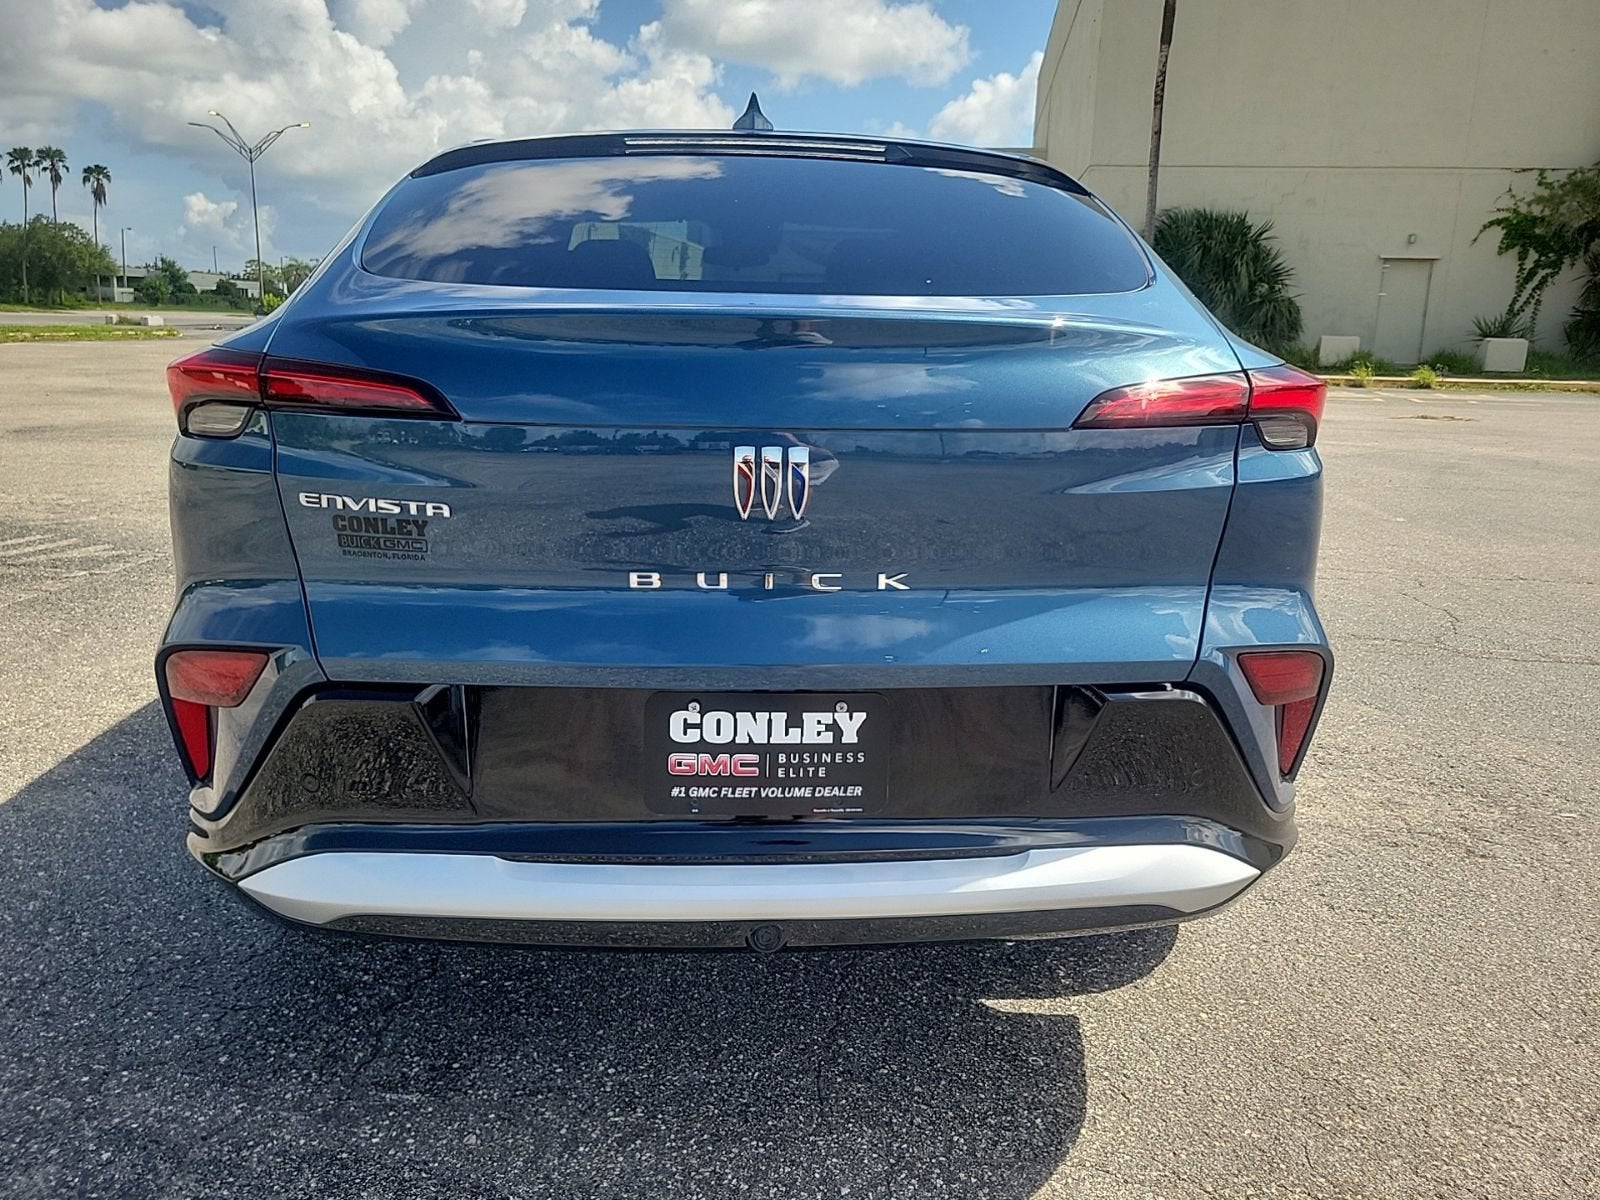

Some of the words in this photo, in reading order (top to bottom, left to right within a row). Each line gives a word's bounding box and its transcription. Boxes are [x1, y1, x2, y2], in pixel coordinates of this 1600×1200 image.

[298, 492, 452, 518] ENVISTA
[332, 514, 429, 537] CONLEY
[340, 535, 380, 549] BUICK
[383, 539, 423, 550] GMC
[392, 552, 426, 561] FLORIDA
[628, 571, 911, 590] BUICK
[669, 710, 867, 744] CONLEY
[668, 753, 760, 776] GMC
[778, 752, 866, 764] BUSINESS
[778, 767, 827, 778] ELITE
[670, 786, 686, 798] #1
[688, 787, 719, 798] GMC
[720, 787, 758, 798] FLEET
[760, 786, 813, 798] VOLUME
[815, 786, 863, 797] DEALER
